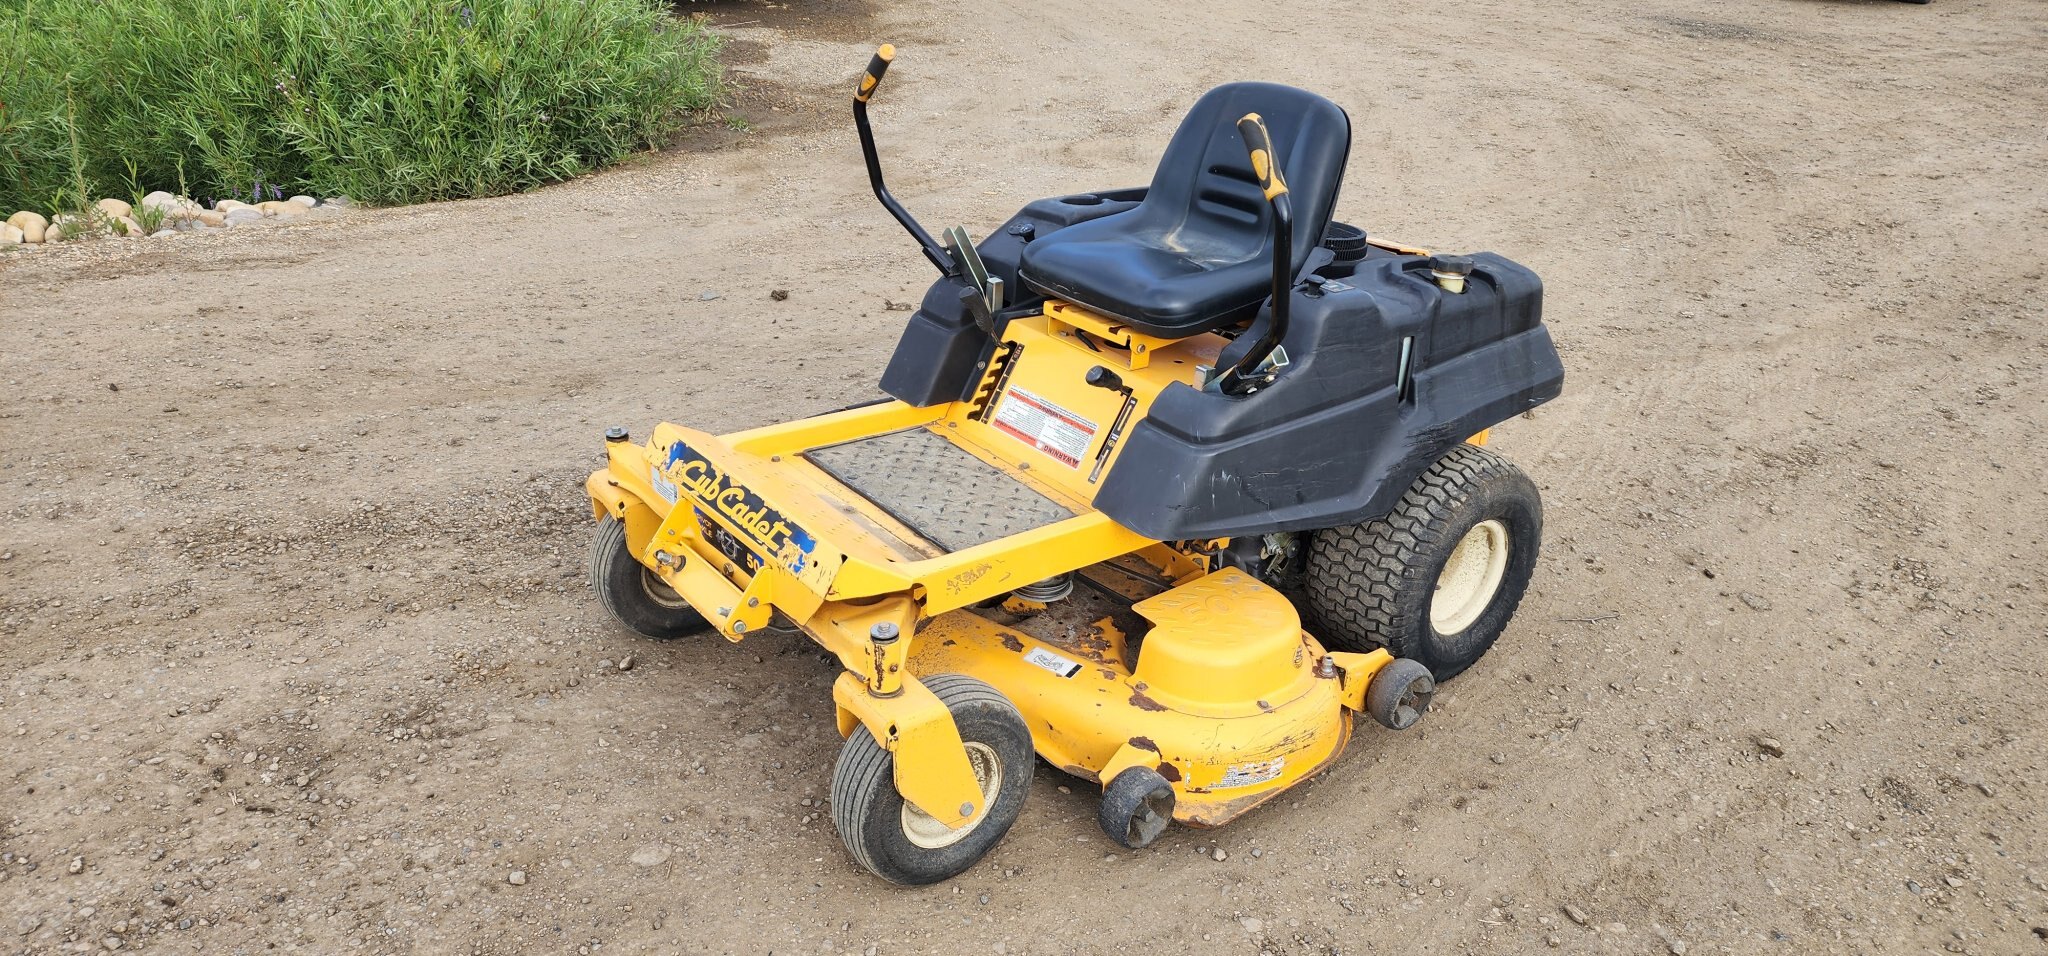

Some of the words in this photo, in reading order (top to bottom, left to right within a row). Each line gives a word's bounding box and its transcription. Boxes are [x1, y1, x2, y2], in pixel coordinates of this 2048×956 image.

[1043, 445, 1074, 465] WARNING
[681, 460, 723, 501] Cub
[717, 486, 793, 552] Cadet
[747, 552, 761, 573] 50
